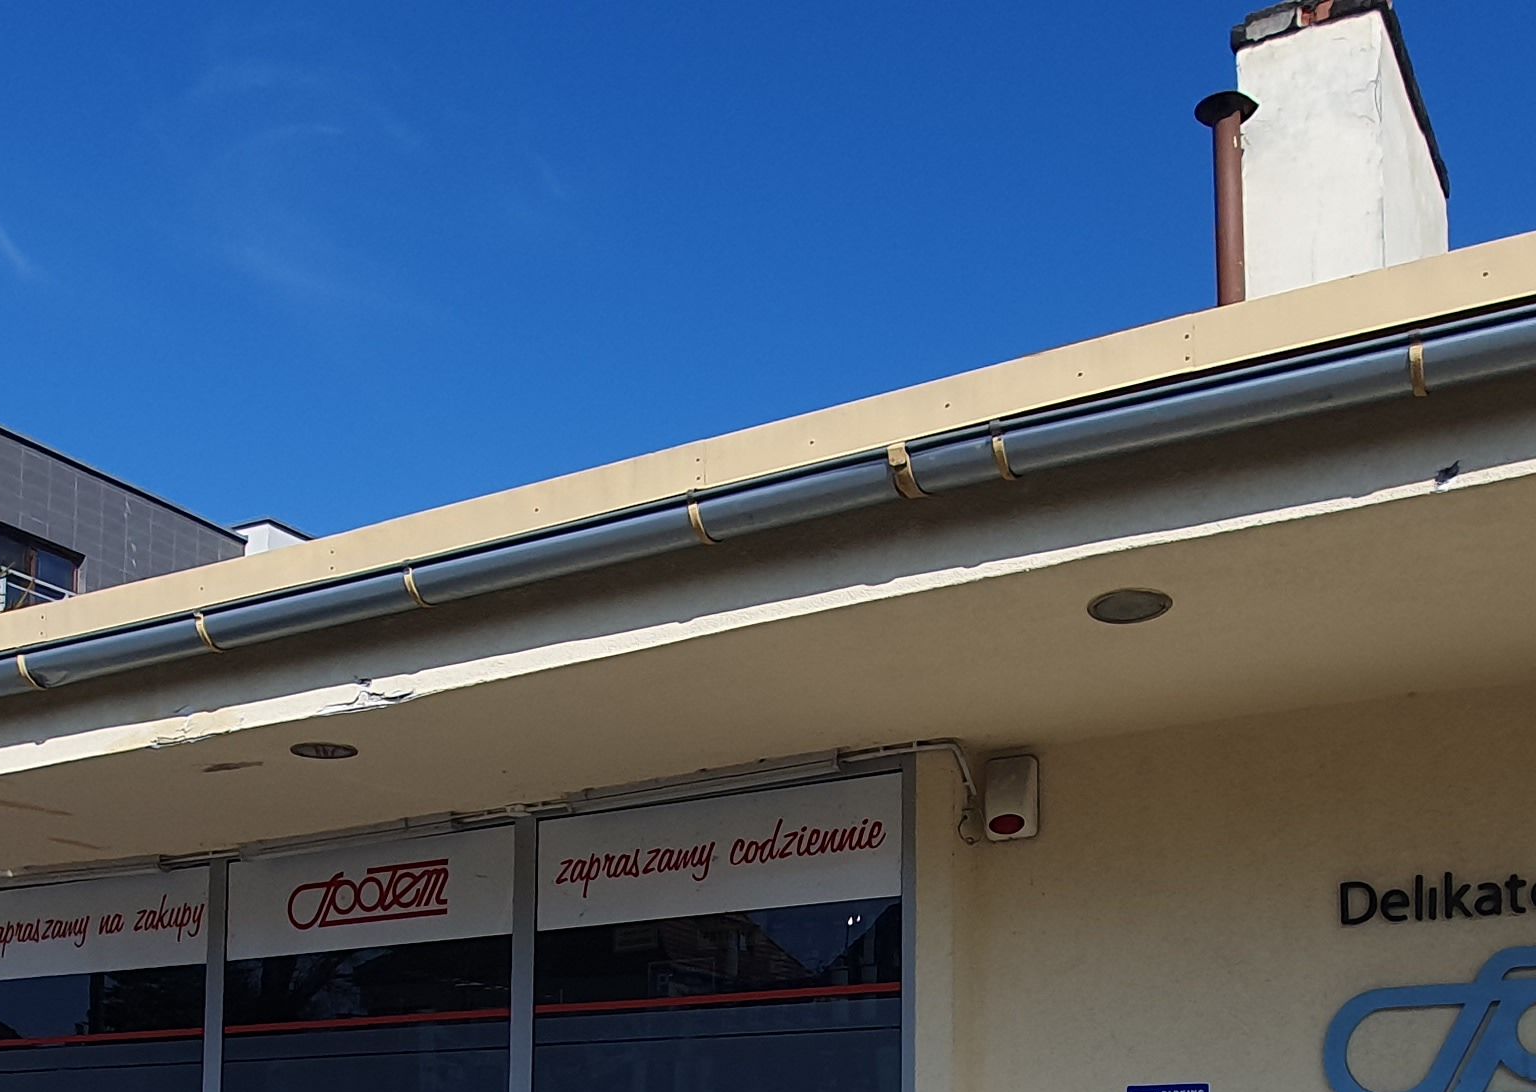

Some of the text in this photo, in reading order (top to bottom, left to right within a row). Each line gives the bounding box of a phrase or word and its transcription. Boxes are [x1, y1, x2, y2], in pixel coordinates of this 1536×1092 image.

[555, 817, 886, 898] zapraszamy codziennie
[98, 912, 125, 935] na
[133, 893, 205, 942] zakupy
